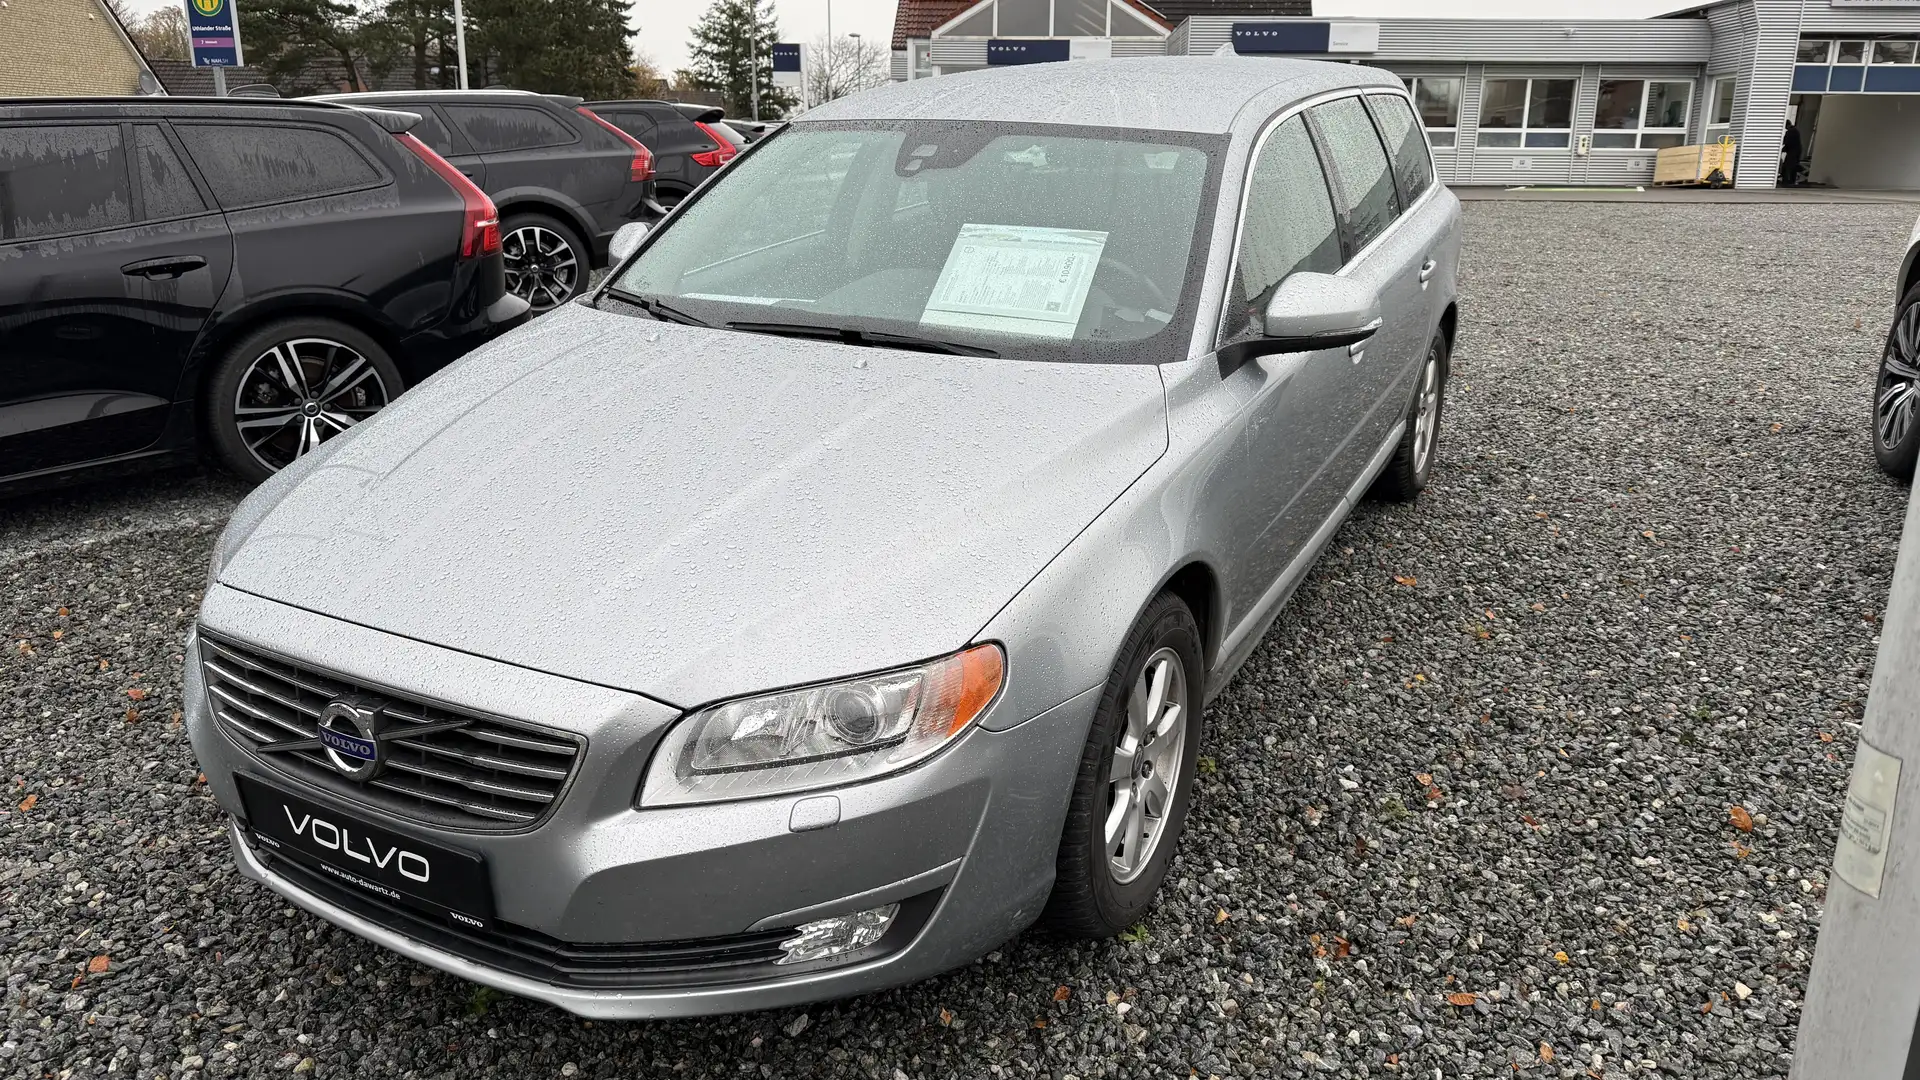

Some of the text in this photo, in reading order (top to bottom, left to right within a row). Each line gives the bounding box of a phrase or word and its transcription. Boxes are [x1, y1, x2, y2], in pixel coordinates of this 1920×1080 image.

[321, 731, 371, 755] VOLVO
[255, 832, 280, 849] VOLVO
[283, 804, 430, 883] VOLVO
[320, 863, 401, 900] www.auto-dawartz.de
[450, 912, 484, 929] VOLVO
